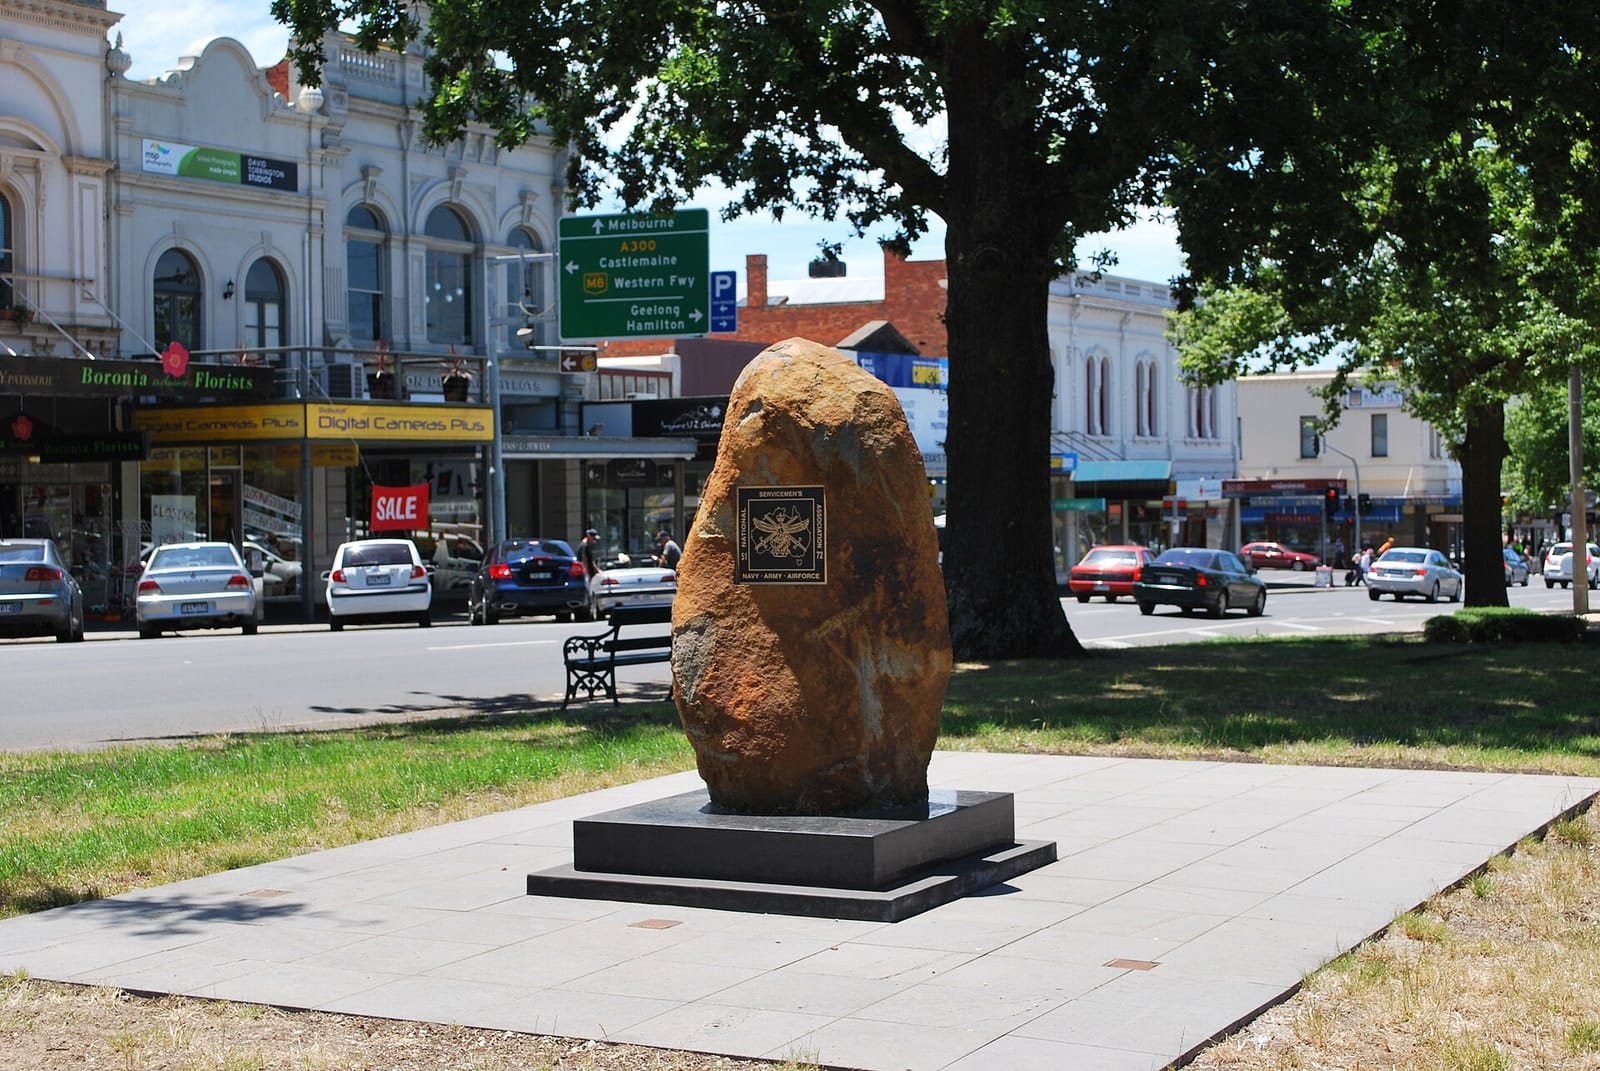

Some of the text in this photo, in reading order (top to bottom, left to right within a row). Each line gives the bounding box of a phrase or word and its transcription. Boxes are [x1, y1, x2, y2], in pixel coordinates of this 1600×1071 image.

[248, 158, 267, 168] DAVID
[248, 166, 285, 179] TORRINGTON
[248, 174, 273, 185] STUDIOS
[608, 218, 675, 231] Melbourne
[620, 239, 657, 253] A300
[599, 255, 678, 269] Castlemaine
[614, 276, 664, 289] Western
[670, 275, 695, 288] Fwy
[715, 275, 732, 298] P
[630, 304, 681, 318] Geelong
[626, 319, 685, 332] Hamilton
[81, 366, 148, 387] Boronia
[194, 370, 254, 390] Florists
[186, 418, 258, 431] Cameras
[262, 417, 299, 429] Plus
[318, 415, 485, 432] Digital Cameras Plus
[759, 490, 803, 498] SERVICEMEN'S
[376, 495, 417, 521] SALE
[815, 551, 824, 560] 72
